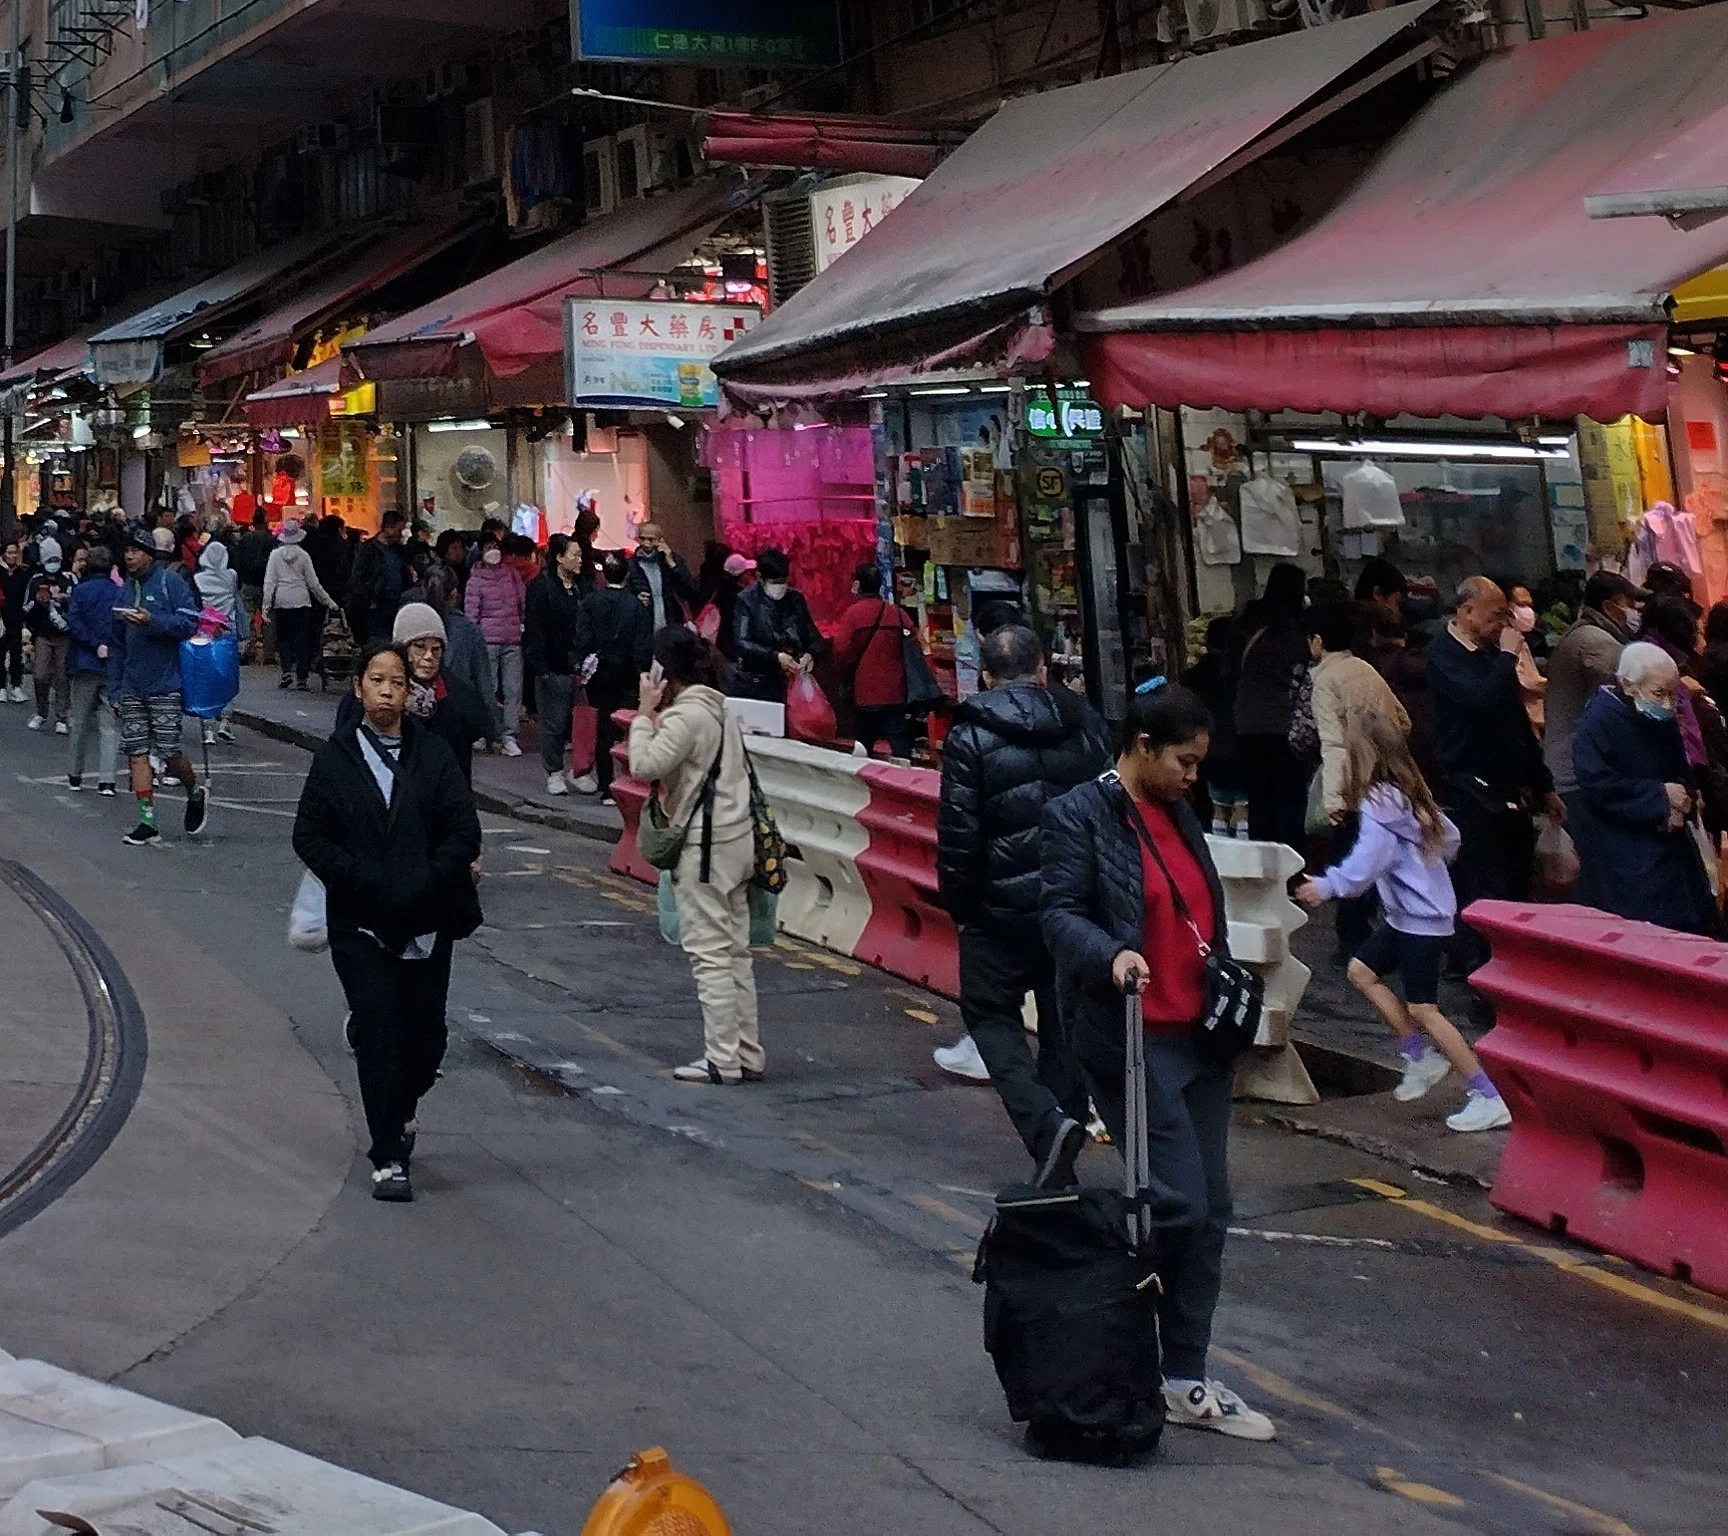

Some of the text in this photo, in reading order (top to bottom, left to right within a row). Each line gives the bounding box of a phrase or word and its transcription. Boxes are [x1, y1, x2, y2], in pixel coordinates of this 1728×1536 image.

[583, 311, 717, 340] 名豐大藥房
